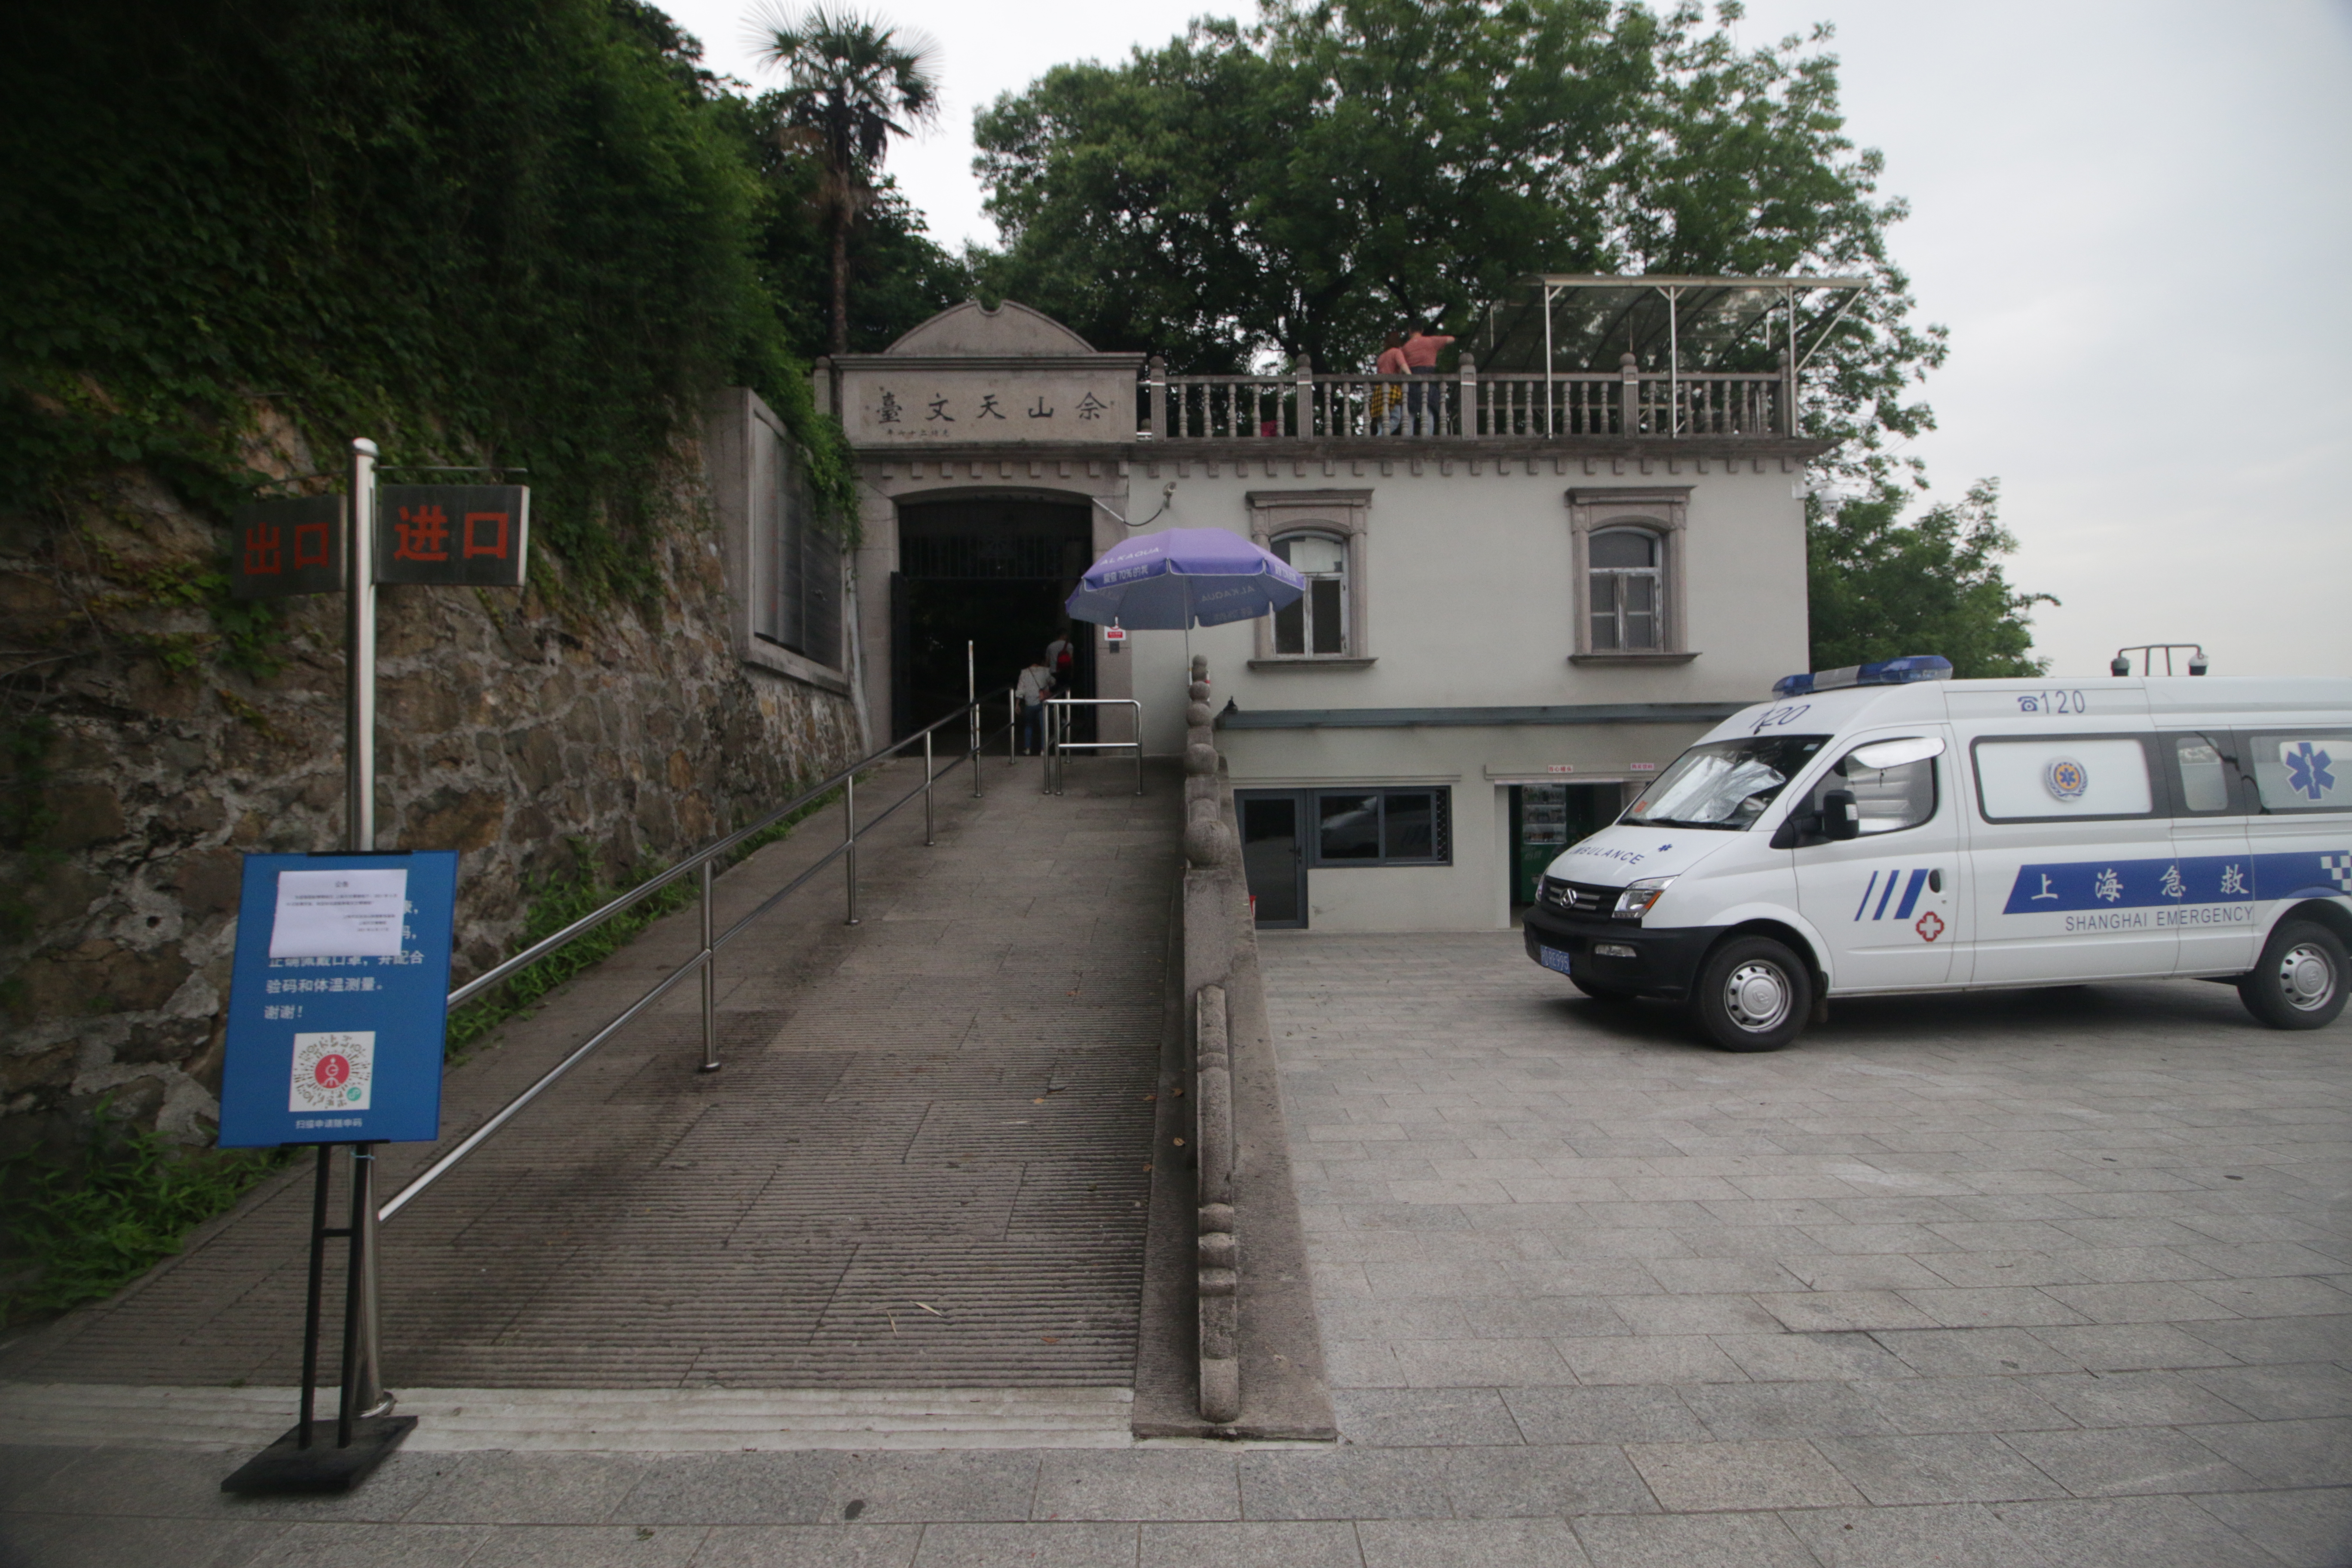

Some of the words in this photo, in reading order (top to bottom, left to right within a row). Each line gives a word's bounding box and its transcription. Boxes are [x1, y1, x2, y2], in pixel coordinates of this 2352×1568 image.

[394, 505, 509, 561] 进口
[244, 522, 329, 575] 出口
[1099, 547, 1159, 565] ALKAQUA
[2041, 690, 2085, 714] 120
[1749, 704, 1811, 728] 120
[2030, 864, 2250, 902] 上海急救
[2065, 913, 2147, 931] SHANGHAI
[2157, 906, 2254, 926] EMERGENCY
[266, 977, 383, 994] 验码和体温测量。
